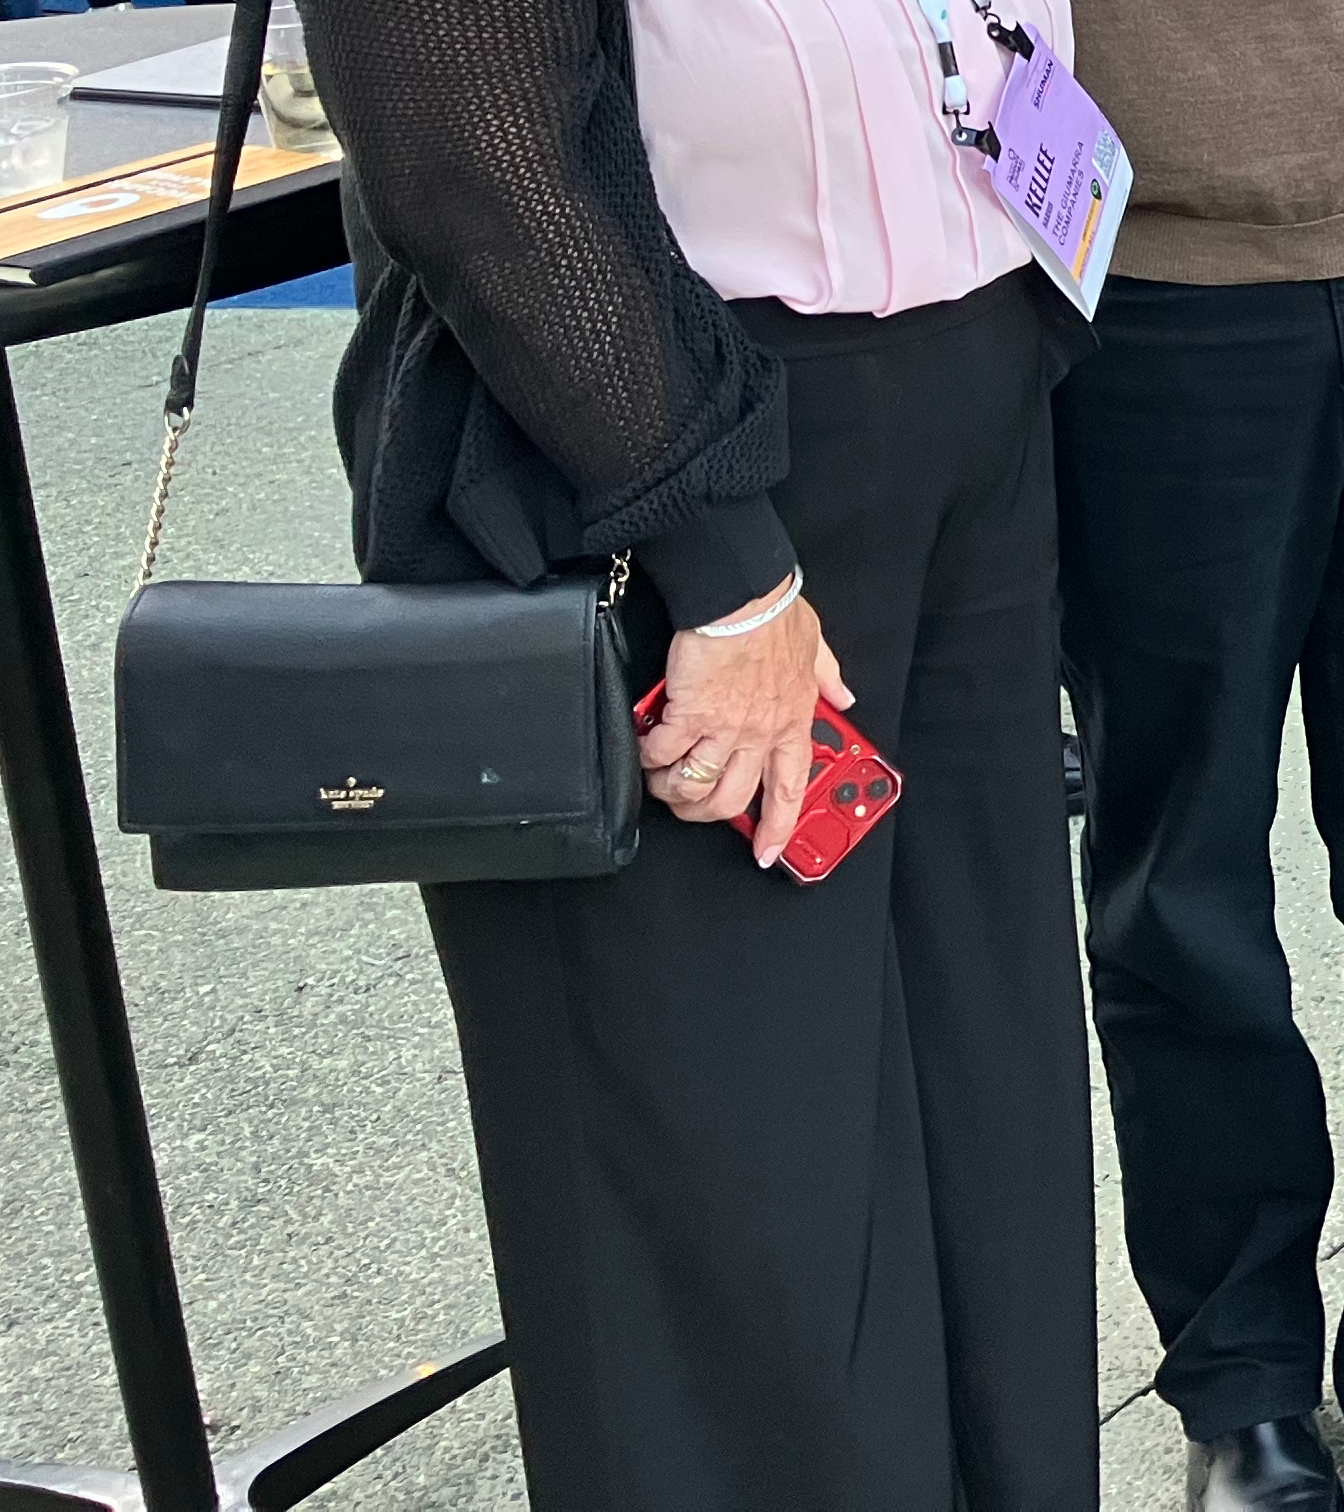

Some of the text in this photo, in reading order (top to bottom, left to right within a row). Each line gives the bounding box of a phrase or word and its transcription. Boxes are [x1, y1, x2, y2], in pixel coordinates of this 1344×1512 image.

[1033, 58, 1054, 110] SHUMAN
[1024, 142, 1056, 219] KELLEE
[1052, 141, 1084, 237] THE GIUMARRA
[1058, 169, 1084, 246] COMPANIES
